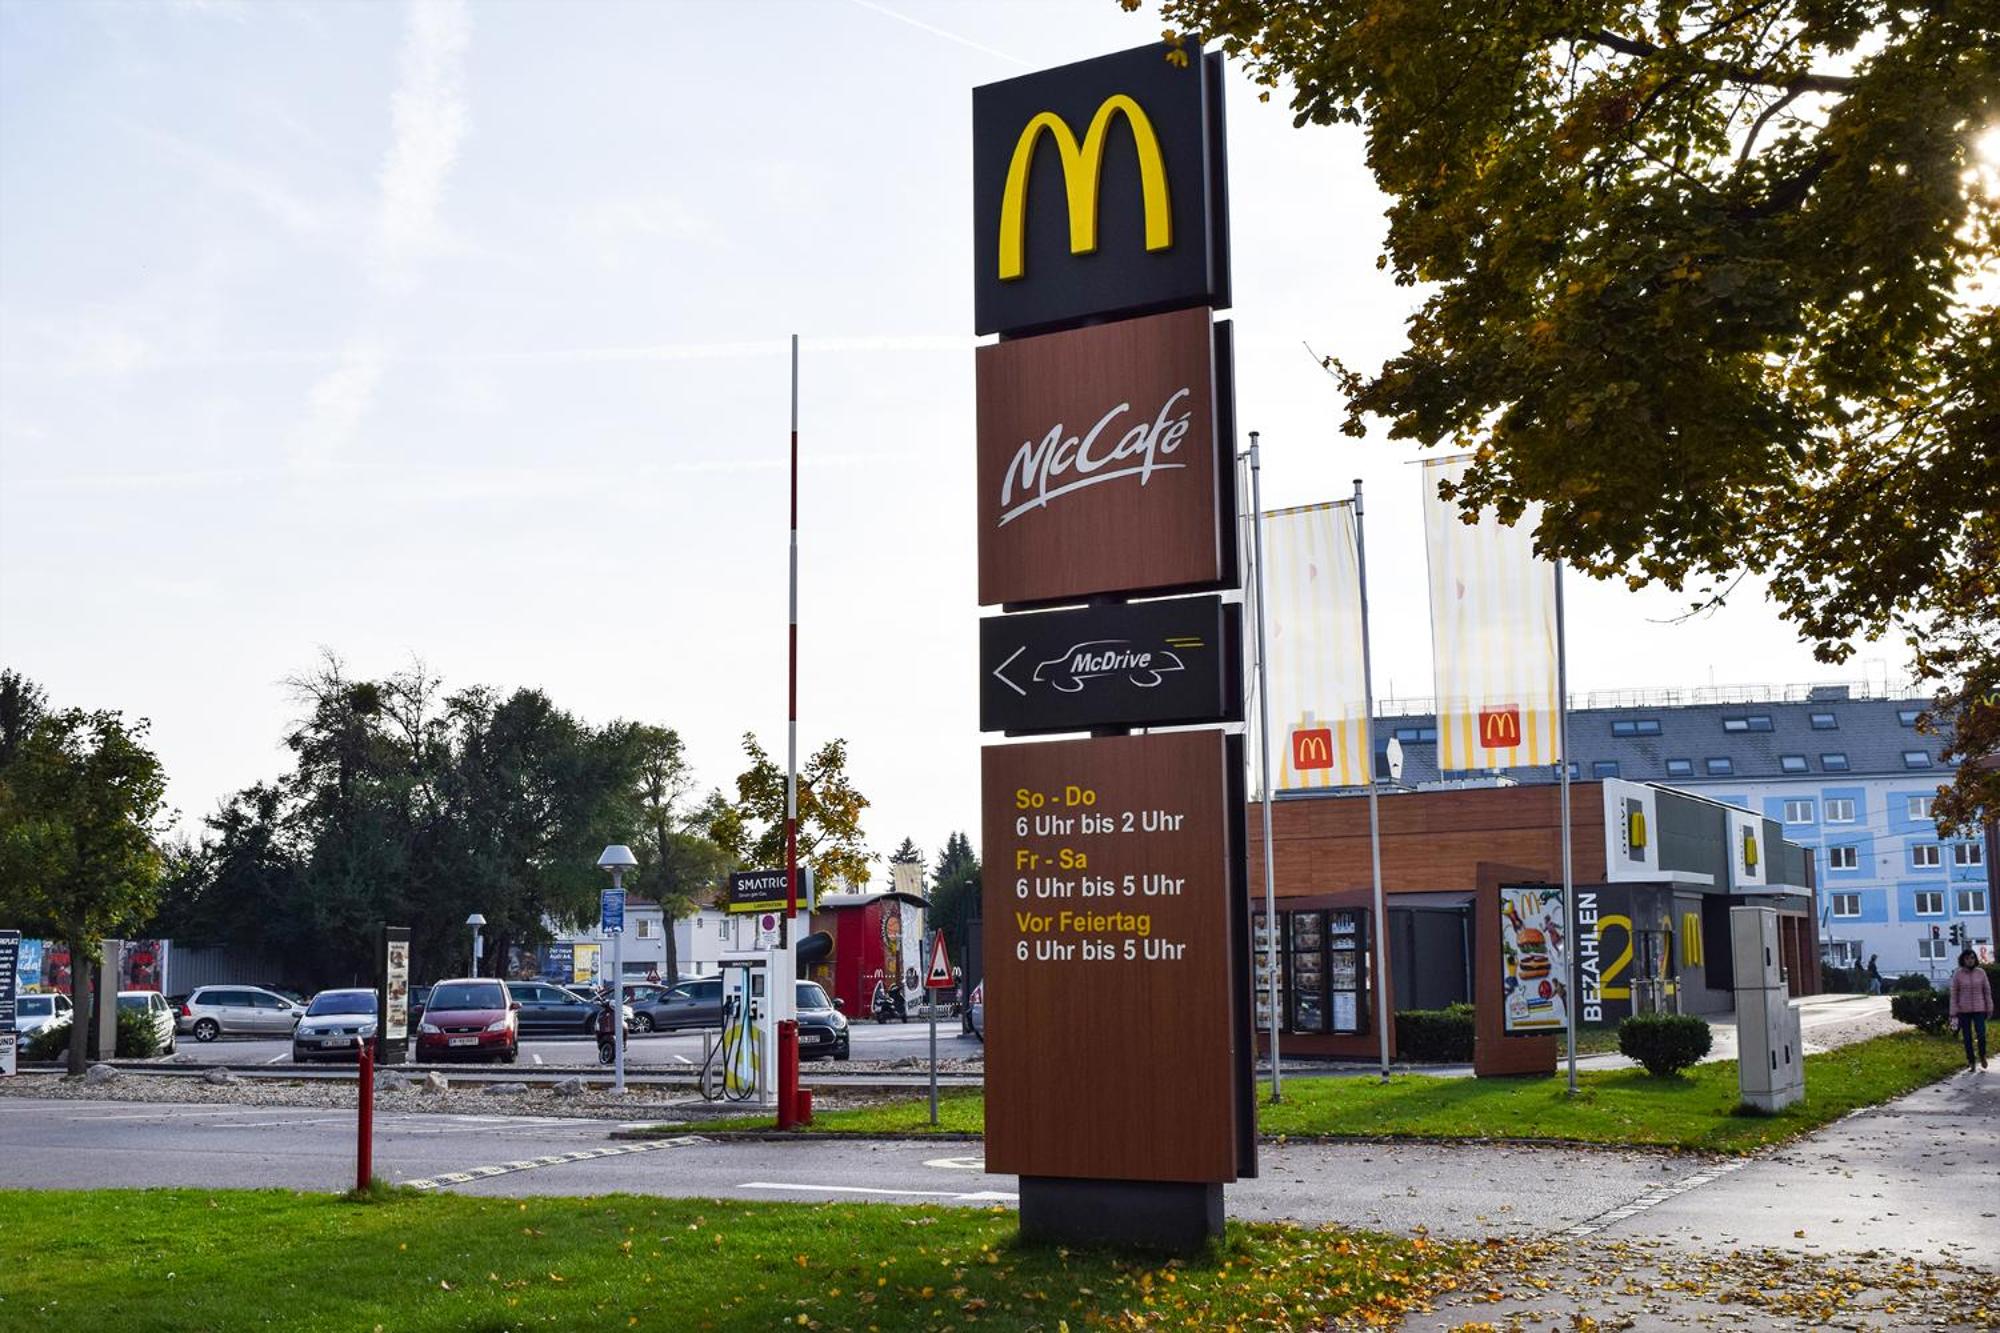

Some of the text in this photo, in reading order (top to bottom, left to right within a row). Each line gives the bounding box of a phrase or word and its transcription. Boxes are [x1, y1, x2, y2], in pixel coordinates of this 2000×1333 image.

[1000, 388, 1191, 508] McCafé
[1070, 649, 1151, 673] McDrive
[1016, 789, 1044, 809] So
[1066, 786, 1097, 807] Do
[1016, 810, 1185, 837] 6 Uhr bis 2 Uhr
[1016, 850, 1039, 870] Fr
[1060, 848, 1088, 870] Sa
[738, 876, 789, 891] SMATRIC
[1016, 874, 1186, 899] 6 Uhr bis 5 Uhr
[1016, 911, 1151, 937] Vor Feiertag
[1016, 938, 1186, 961] 6 Uhr bis 5 Uhr
[1578, 893, 1602, 1022] BEZAHLEN
[1596, 914, 1634, 1000] 2
